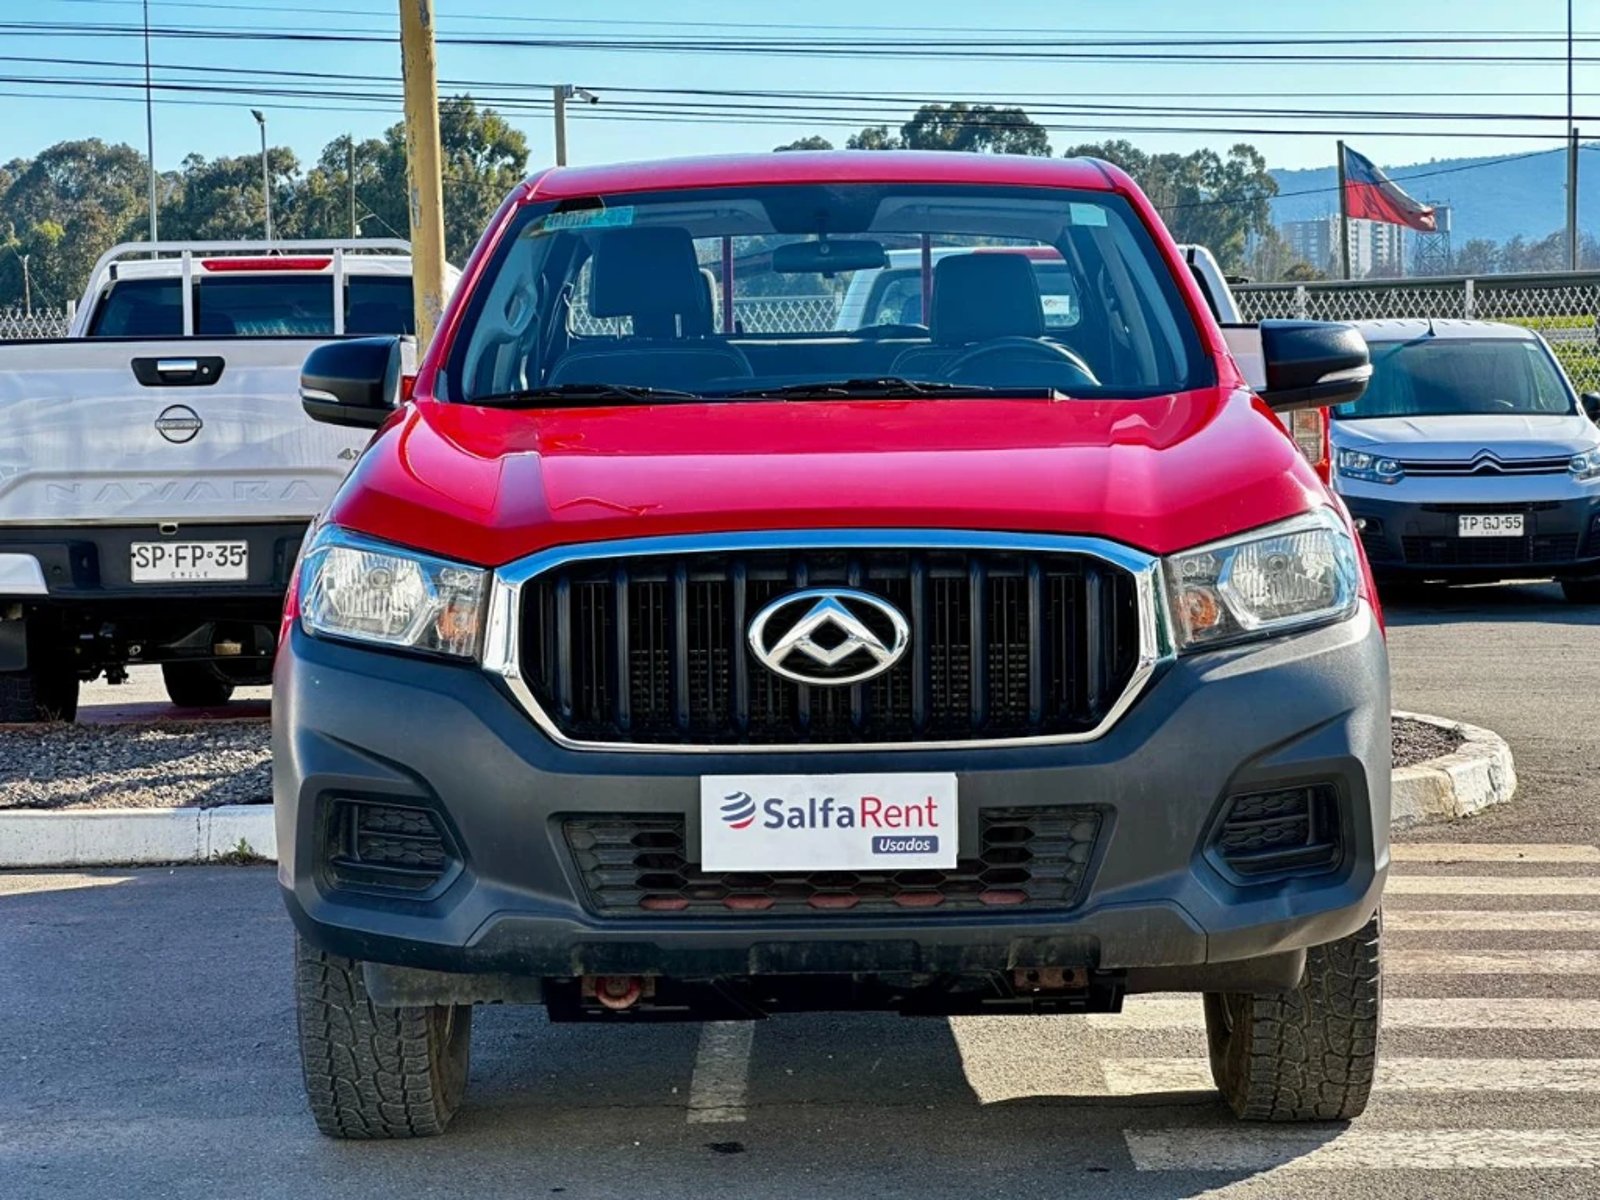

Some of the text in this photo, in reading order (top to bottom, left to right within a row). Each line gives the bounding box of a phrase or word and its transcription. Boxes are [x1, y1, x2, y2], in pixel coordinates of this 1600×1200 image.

[46, 479, 319, 504] NAVARA
[763, 796, 939, 829] SalfaRent
[879, 837, 931, 852] Usados
